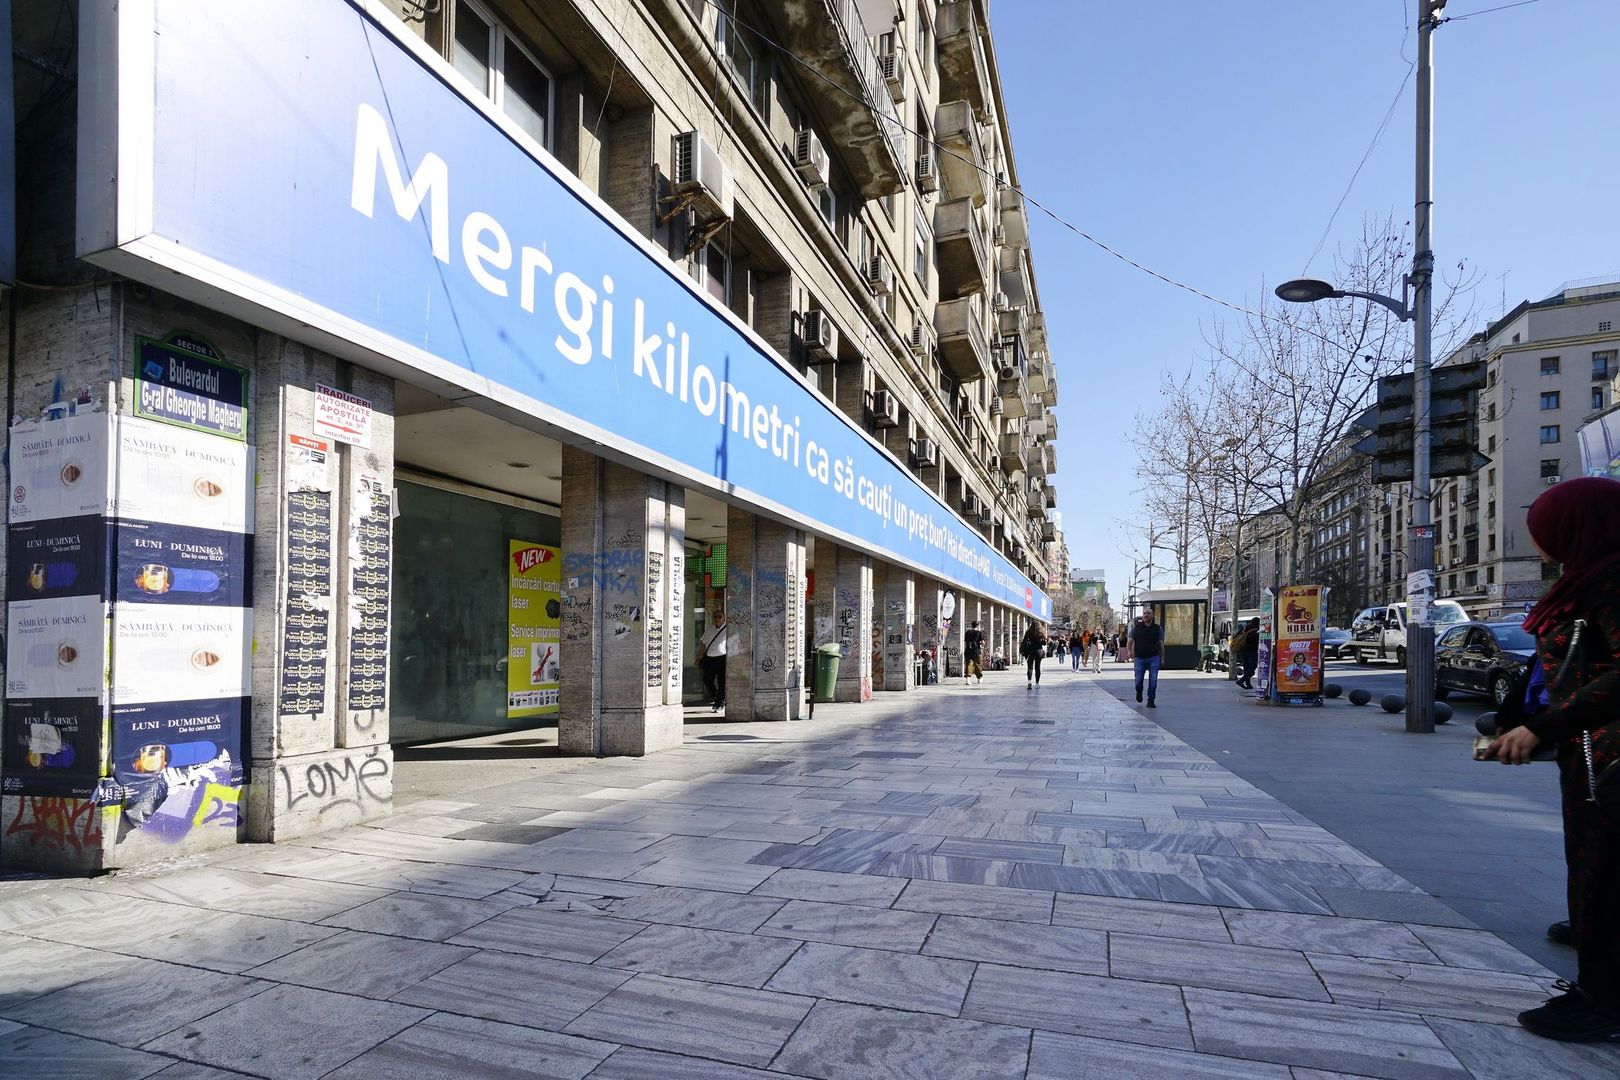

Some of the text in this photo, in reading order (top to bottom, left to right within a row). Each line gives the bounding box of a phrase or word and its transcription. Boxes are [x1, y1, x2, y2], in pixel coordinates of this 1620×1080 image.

[351, 102, 614, 365] Mergi
[634, 298, 800, 467] kilometri
[806, 441, 829, 485] ca
[834, 456, 854, 499] să
[858, 476, 892, 528] cauți
[894, 499, 907, 530] un
[908, 508, 928, 550] preț
[929, 514, 947, 552] bun?
[178, 340, 207, 354] SECTOR
[170, 358, 220, 394] Bulevardul
[317, 384, 370, 408] TRADUCERI
[142, 381, 242, 430] G-ral Gheorghe Magheru
[317, 395, 370, 417] AUTORIZATE
[27, 540, 42, 548] LUNI
[135, 539, 162, 549] LUNI
[170, 542, 223, 555] DUMINICĂ
[521, 550, 546, 570] NEW
[511, 598, 528, 609] laser
[511, 624, 535, 638] Service
[1287, 624, 1315, 633] HORIA
[510, 647, 526, 658] laser
[132, 721, 160, 731] LUNI
[168, 714, 220, 727] DUMINICĂ
